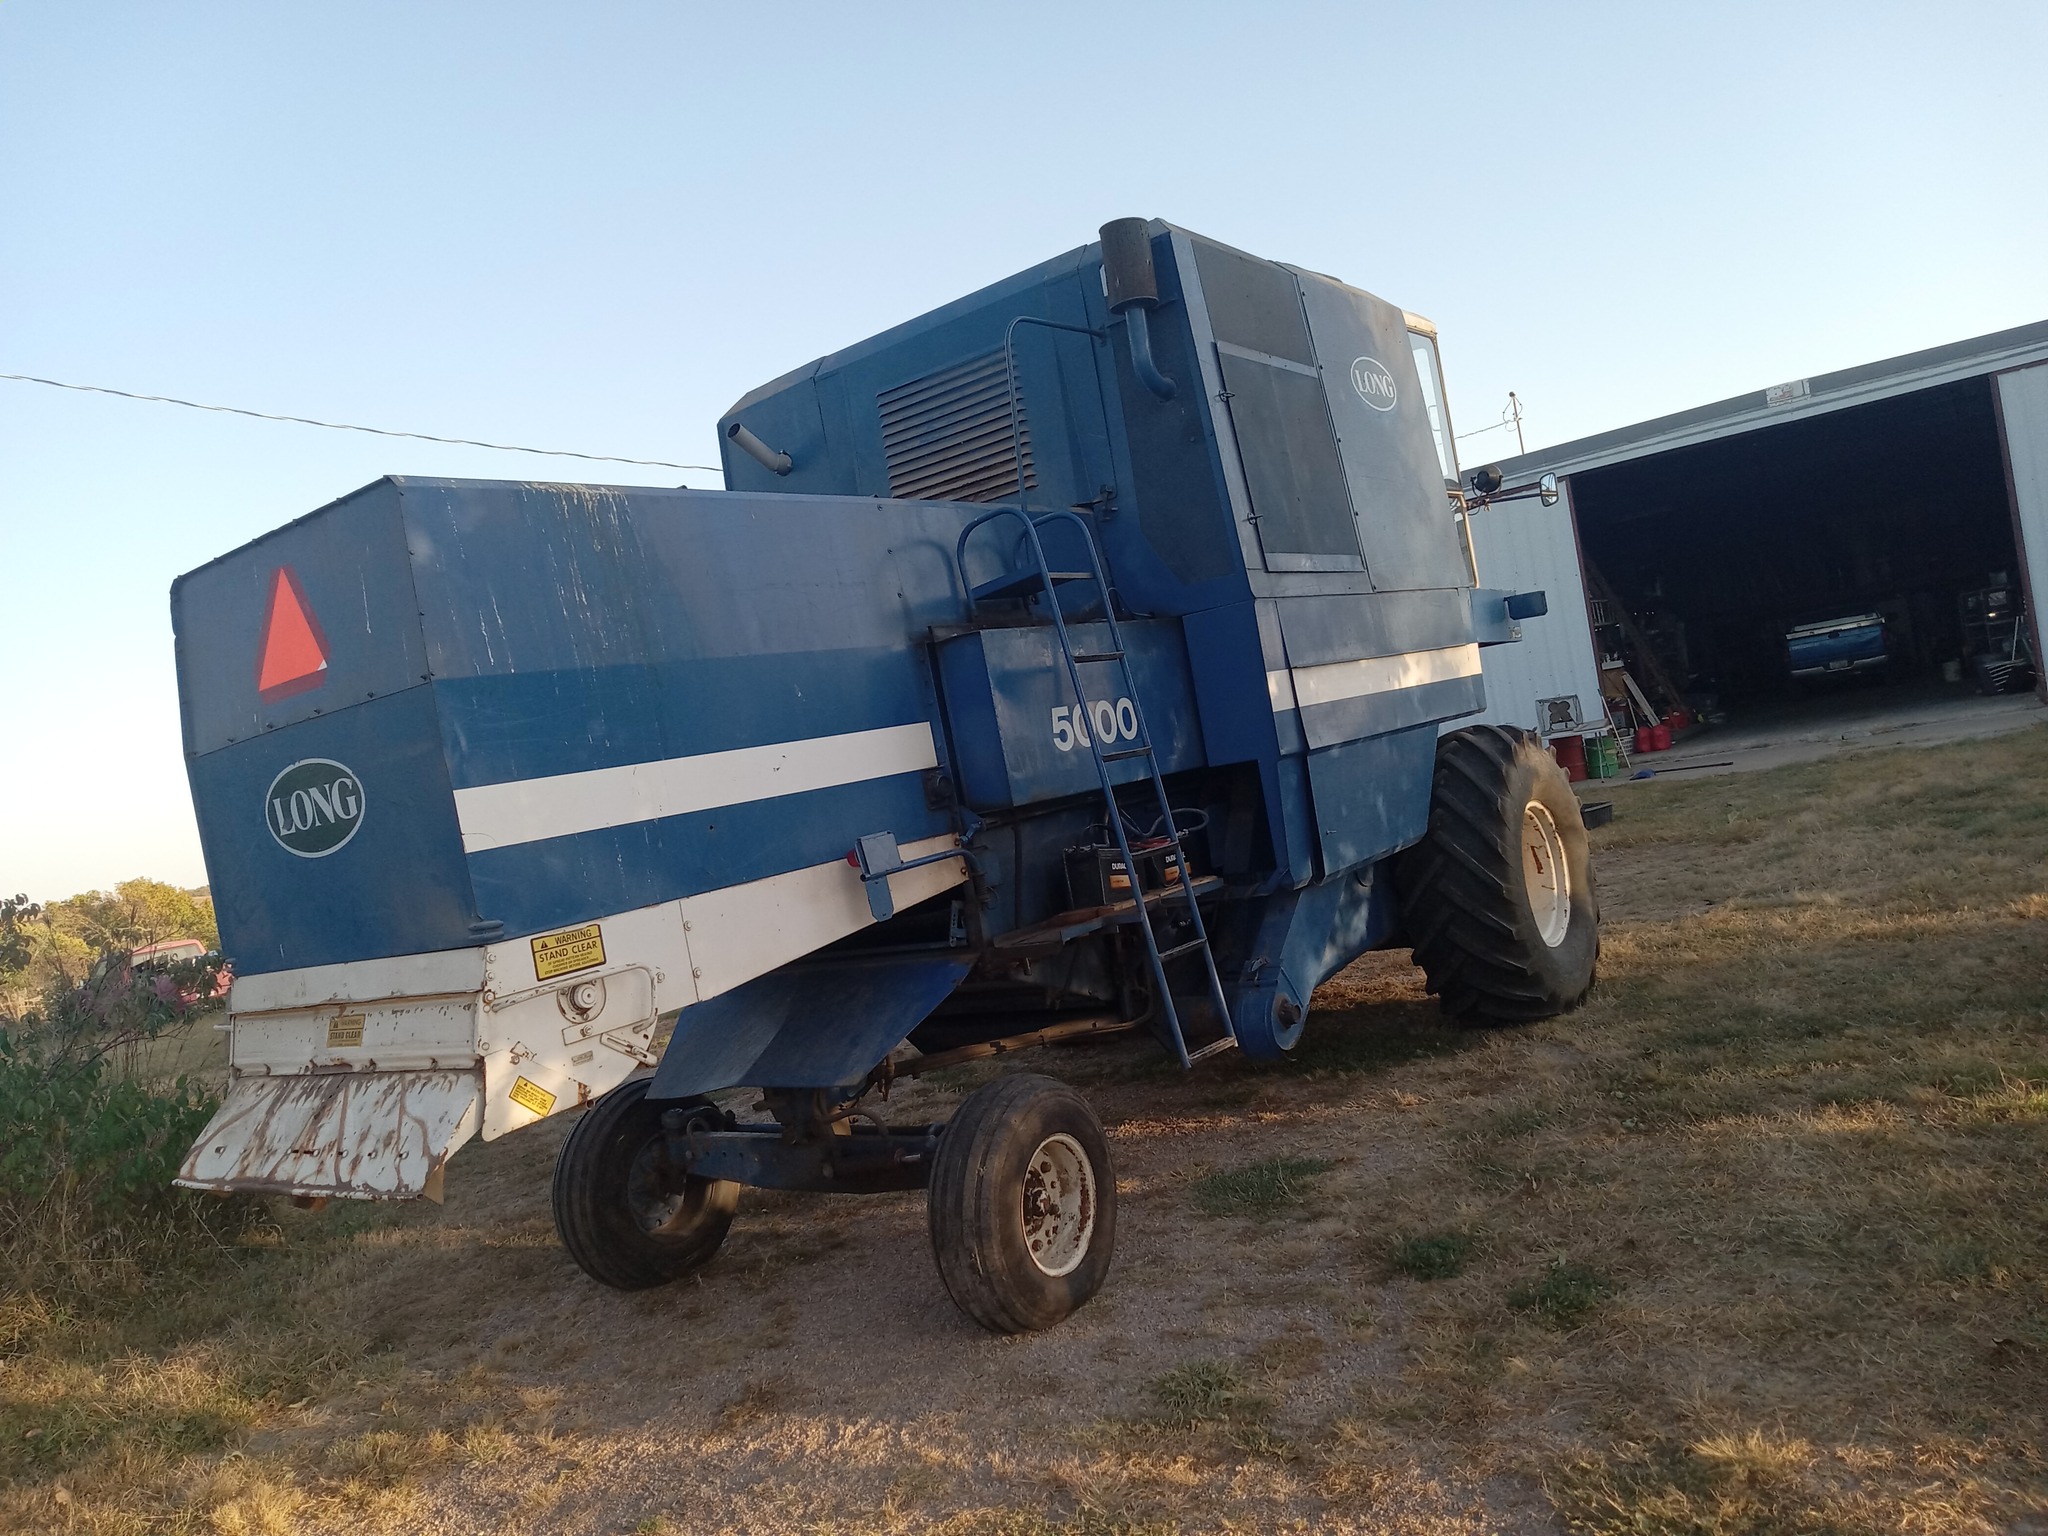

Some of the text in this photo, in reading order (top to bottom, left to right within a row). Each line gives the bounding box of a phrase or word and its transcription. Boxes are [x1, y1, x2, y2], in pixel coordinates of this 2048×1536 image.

[1355, 370, 1394, 398] LONG
[1051, 697, 1138, 752] 5000
[272, 778, 358, 836] LONG
[554, 929, 591, 945] WARNING
[539, 941, 597, 962] STAND CLEAR
